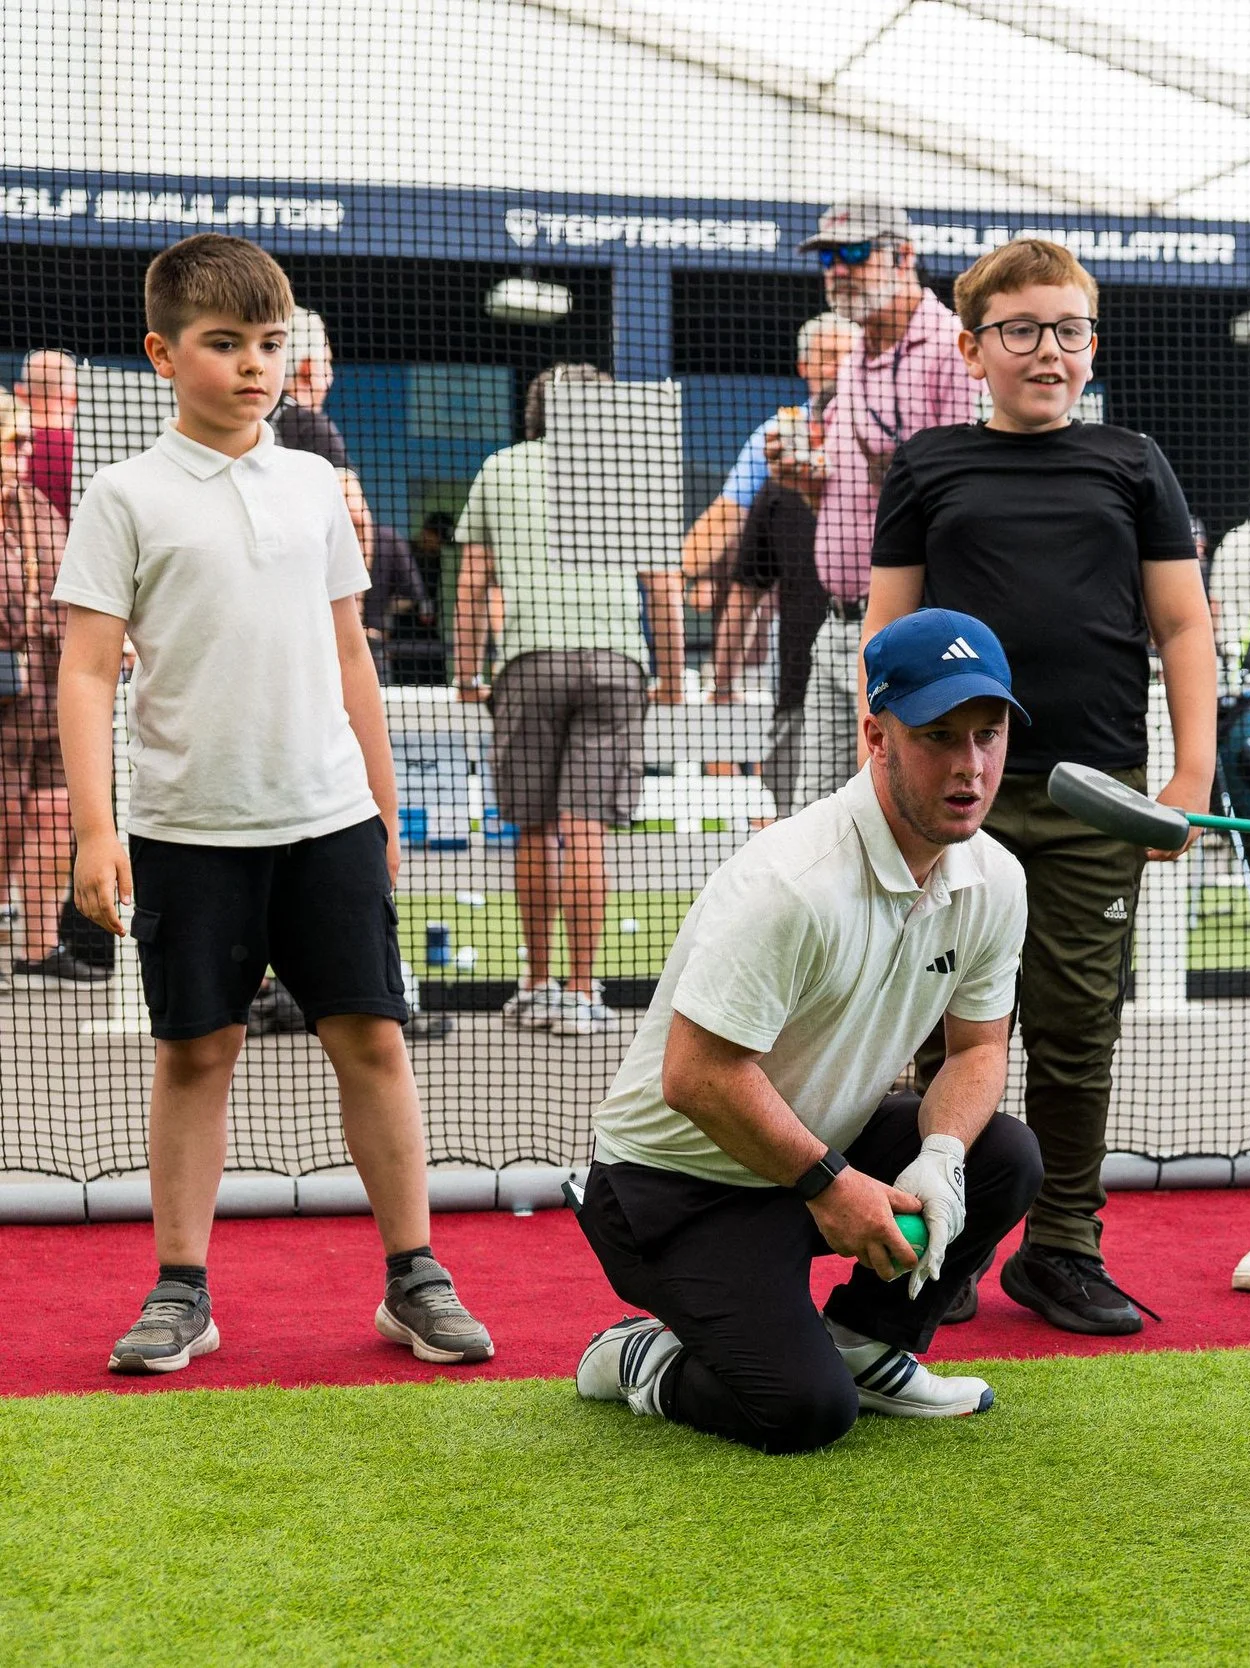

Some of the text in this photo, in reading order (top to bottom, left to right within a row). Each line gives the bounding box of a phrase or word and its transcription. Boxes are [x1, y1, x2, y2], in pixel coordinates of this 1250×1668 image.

[0, 186, 345, 232] OLF SIMULATOR
[537, 213, 781, 253] TOPTRACER
[1104, 910, 1127, 919] adidas
